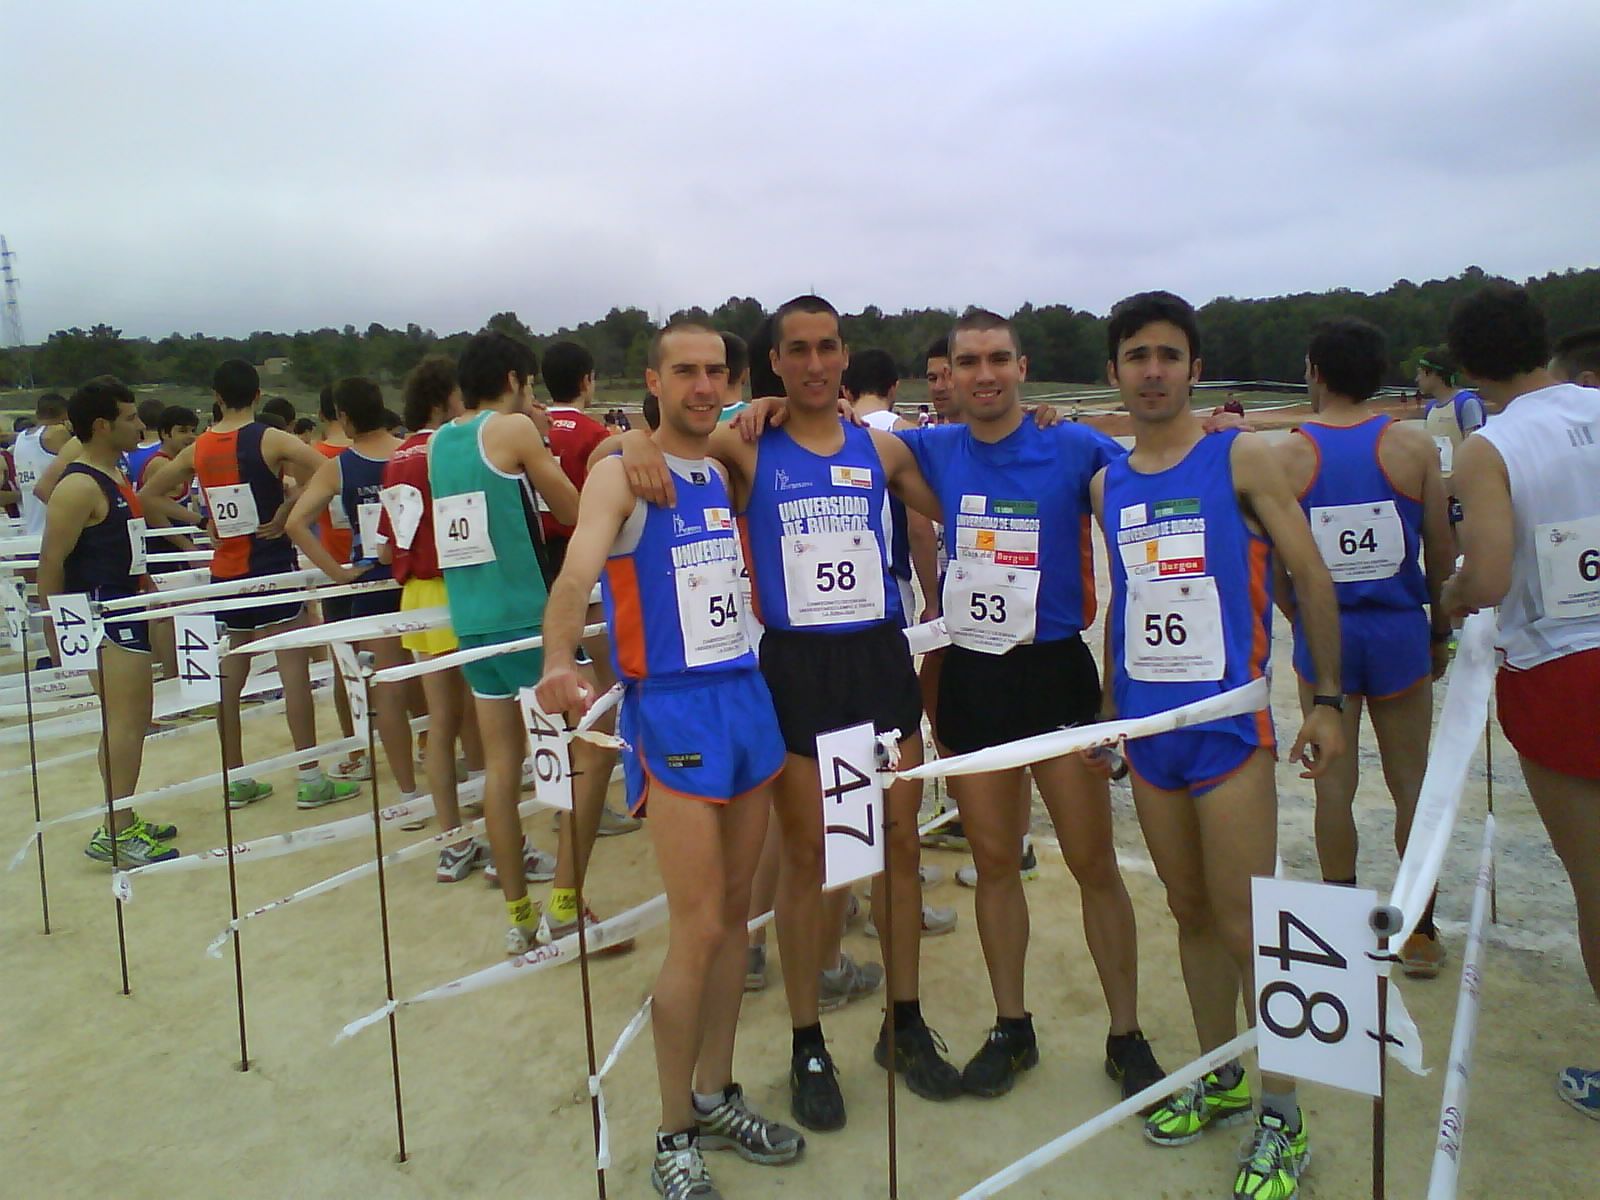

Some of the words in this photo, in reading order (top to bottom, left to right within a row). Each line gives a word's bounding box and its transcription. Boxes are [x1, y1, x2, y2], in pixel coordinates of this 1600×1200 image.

[216, 502, 239, 520] 20
[778, 495, 869, 522] UNIVERSIDAD
[448, 518, 469, 541] 40
[782, 519, 804, 536] DE
[808, 515, 869, 535] BURGOS
[1339, 527, 1378, 555] 64
[997, 552, 1030, 564] Burgos
[1161, 560, 1199, 573] Burgos
[817, 561, 856, 592] 58
[709, 593, 738, 628] 54
[970, 592, 1006, 624] 53
[56, 607, 90, 657] 43
[1145, 613, 1187, 646] 56
[177, 628, 212, 685] 44
[530, 708, 561, 784] 46
[825, 757, 874, 847] 47
[1259, 910, 1348, 1044] 48
